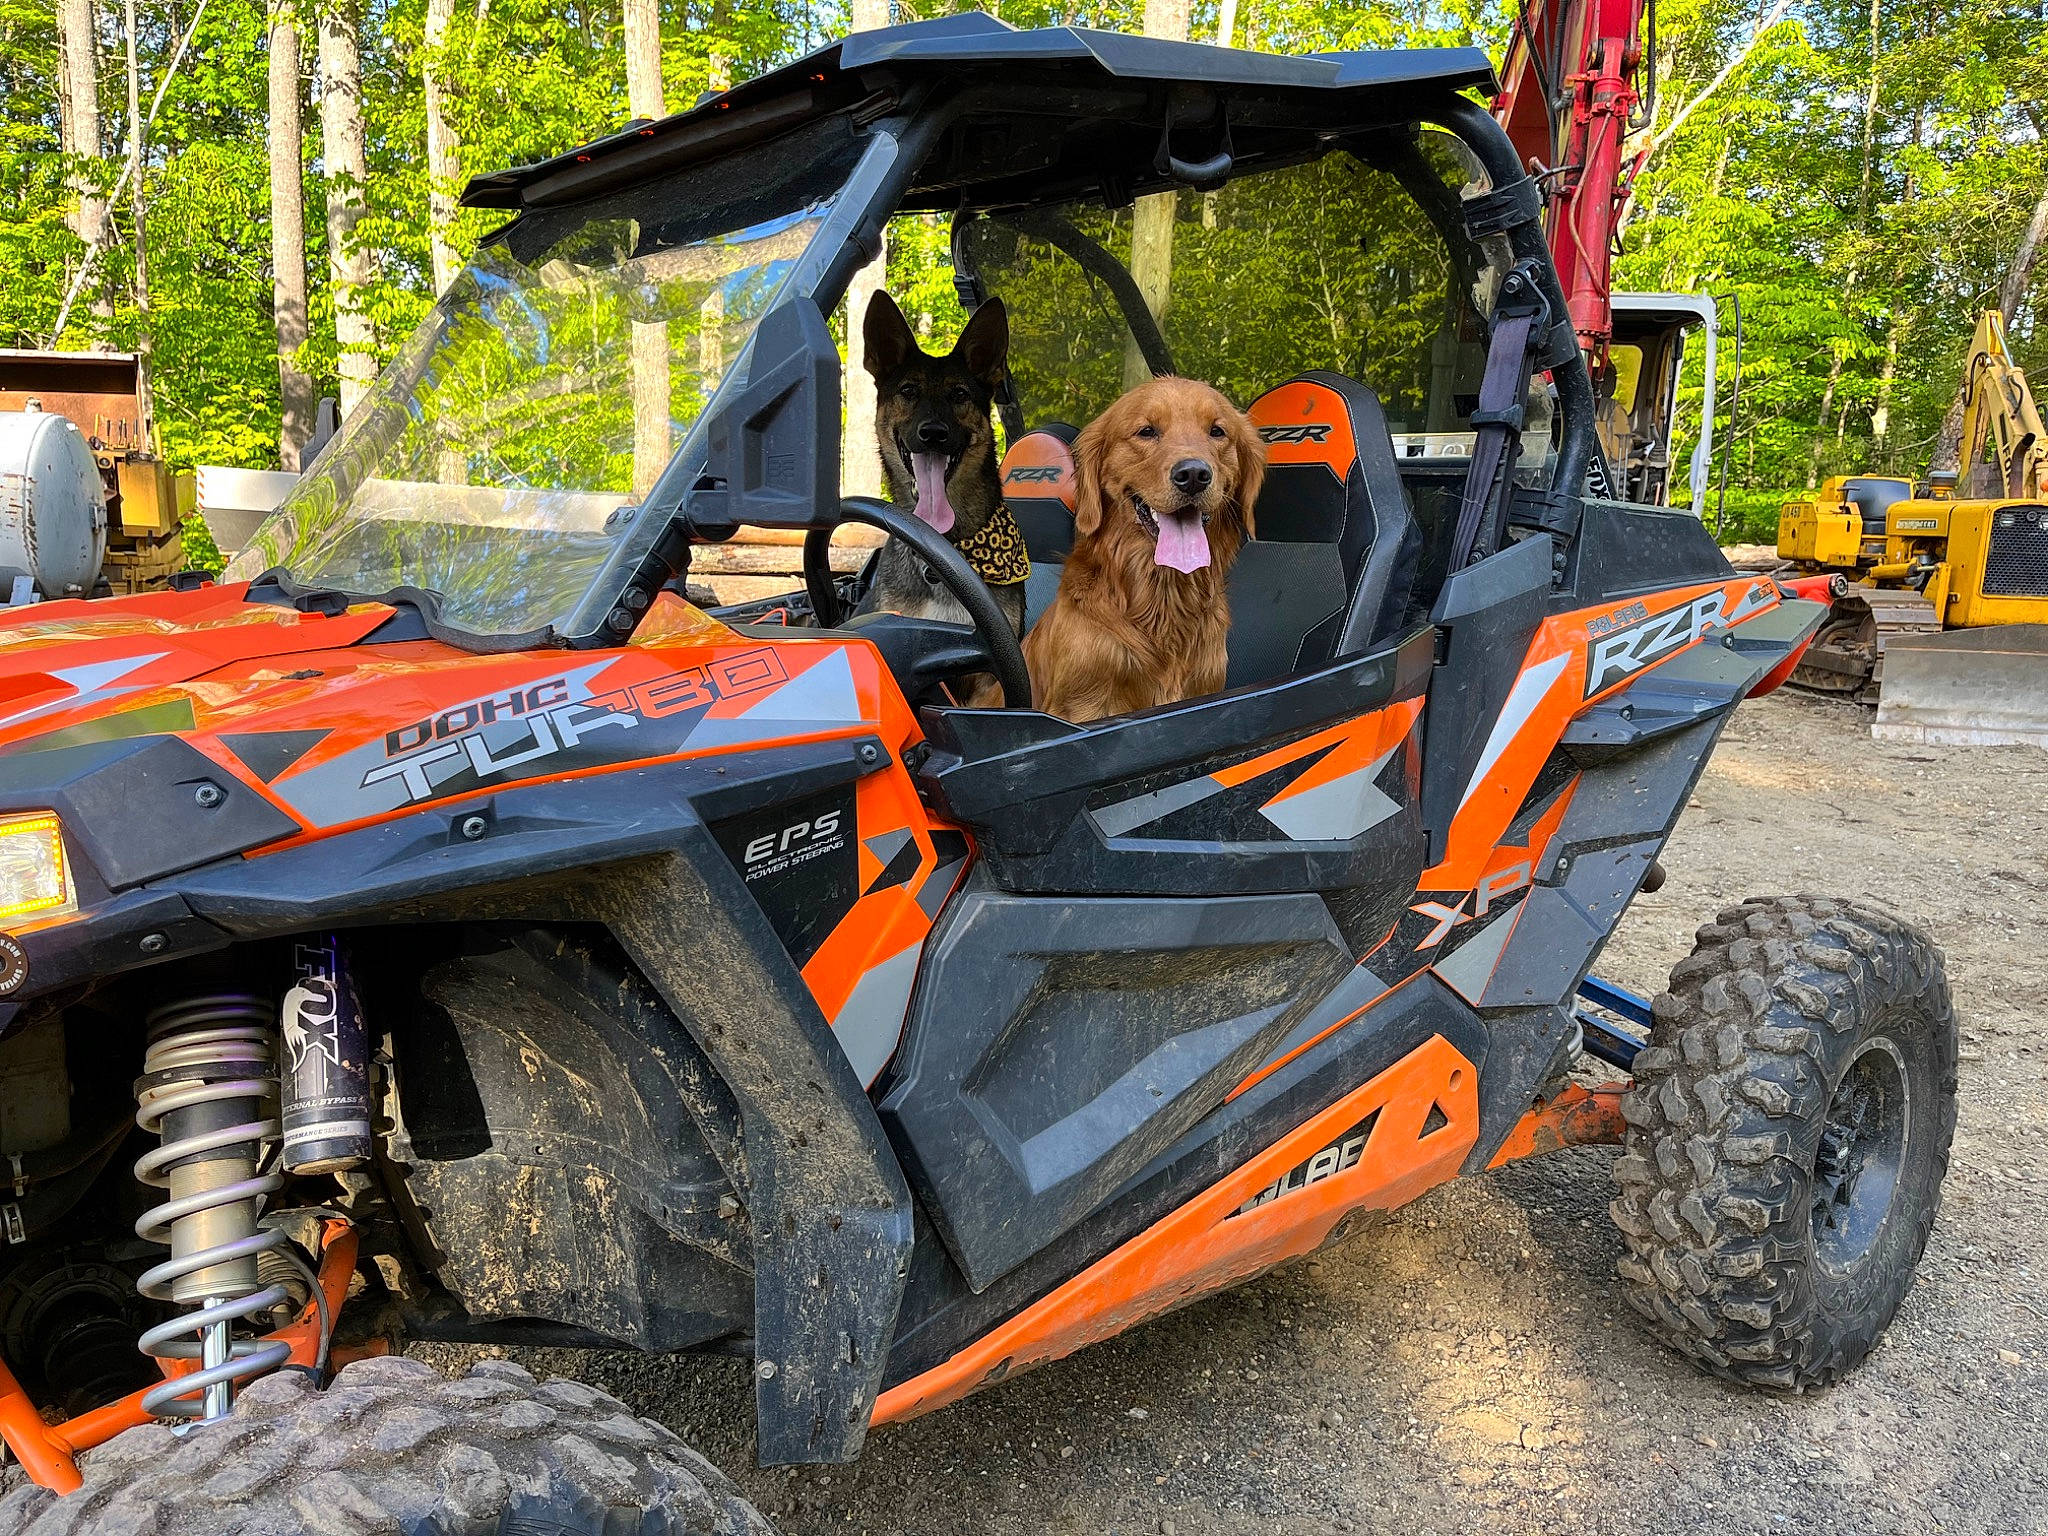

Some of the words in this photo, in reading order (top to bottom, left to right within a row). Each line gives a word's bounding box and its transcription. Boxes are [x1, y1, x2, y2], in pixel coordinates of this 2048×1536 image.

[1004, 466, 1063, 484] RZR
[1585, 601, 1648, 637] POLARIS
[1588, 590, 1729, 697] RZR
[359, 647, 789, 800] TURBO
[385, 678, 569, 759] DOHC
[744, 810, 841, 863] EPS
[747, 834, 843, 873] ELECTRONIC
[745, 861, 790, 882] POWER
[791, 840, 845, 866] STEERING
[1408, 859, 1532, 952] XP
[319, 1096, 358, 1106] BYPASS
